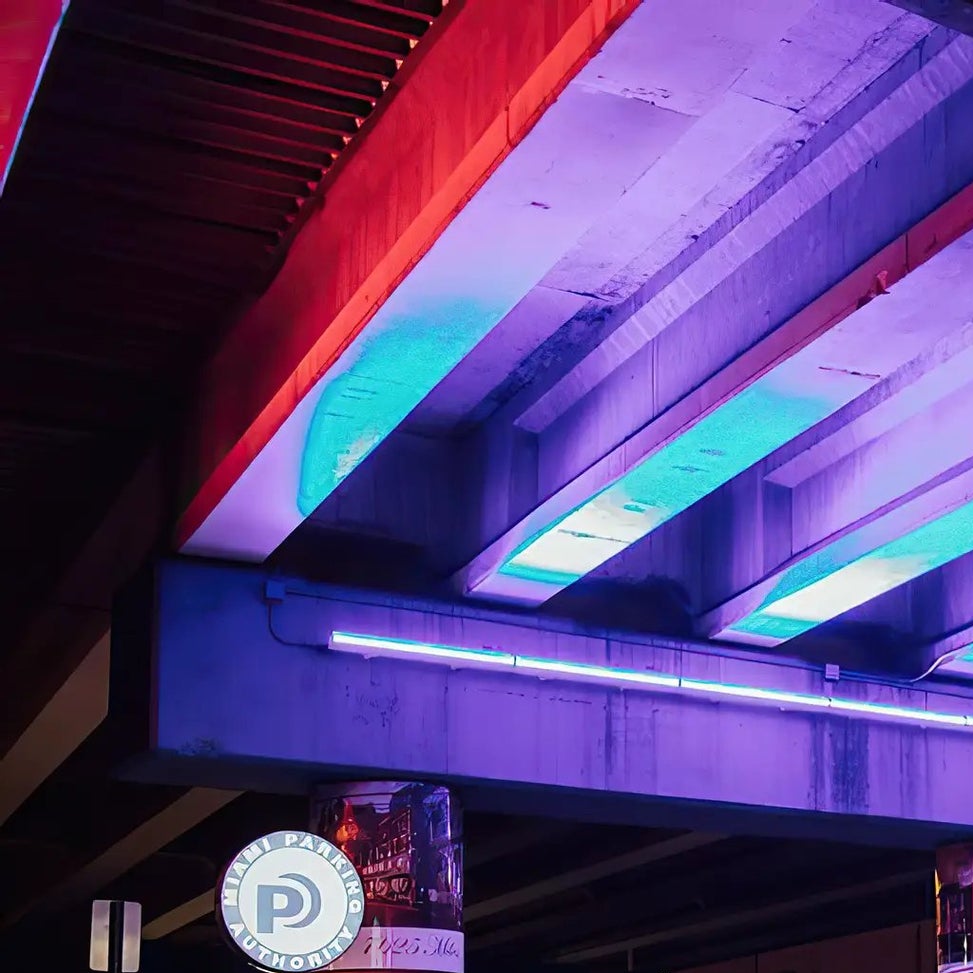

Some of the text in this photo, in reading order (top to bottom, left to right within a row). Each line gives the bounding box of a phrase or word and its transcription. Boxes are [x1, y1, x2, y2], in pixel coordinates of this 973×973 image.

[222, 833, 363, 914] MIAMI PARKING
[229, 922, 354, 970] AUTHORITY
